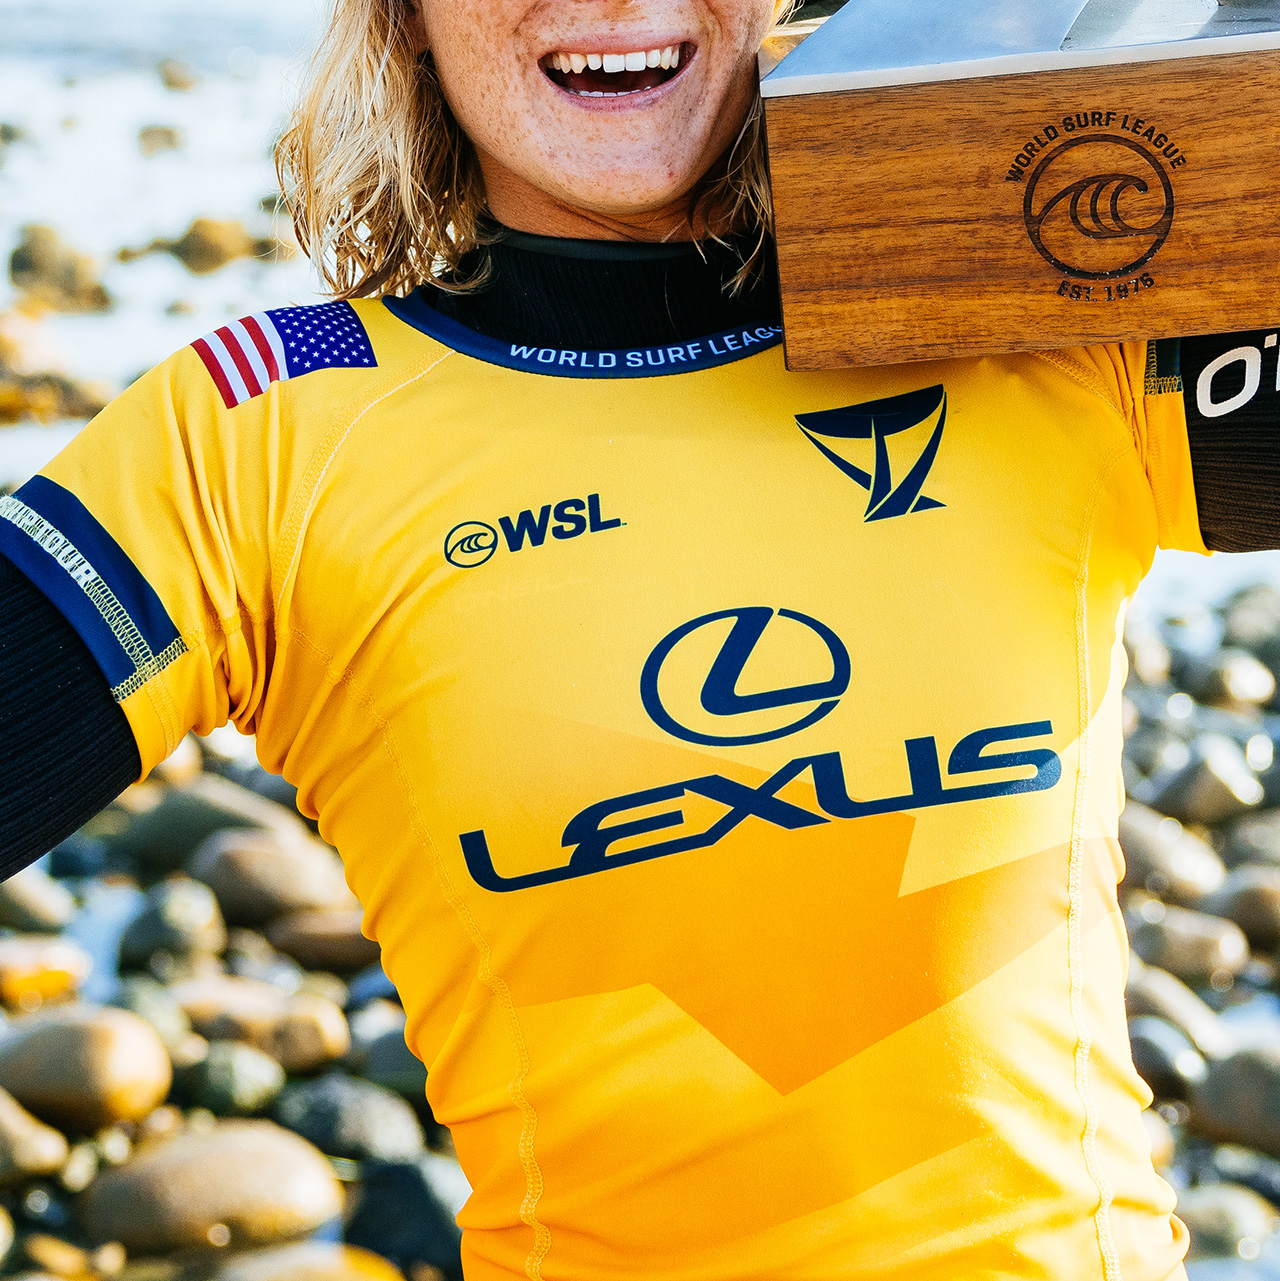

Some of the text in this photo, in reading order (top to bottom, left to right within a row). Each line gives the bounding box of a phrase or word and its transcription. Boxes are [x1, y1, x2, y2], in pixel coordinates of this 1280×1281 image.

[1005, 111, 1187, 183] WORLD SURF LEAGUE
[1056, 272, 1155, 302] EST. 1976
[510, 344, 616, 369] WORLD
[626, 342, 702, 368] SURF
[498, 493, 621, 553] WSL
[458, 719, 1062, 894] LEXUS
